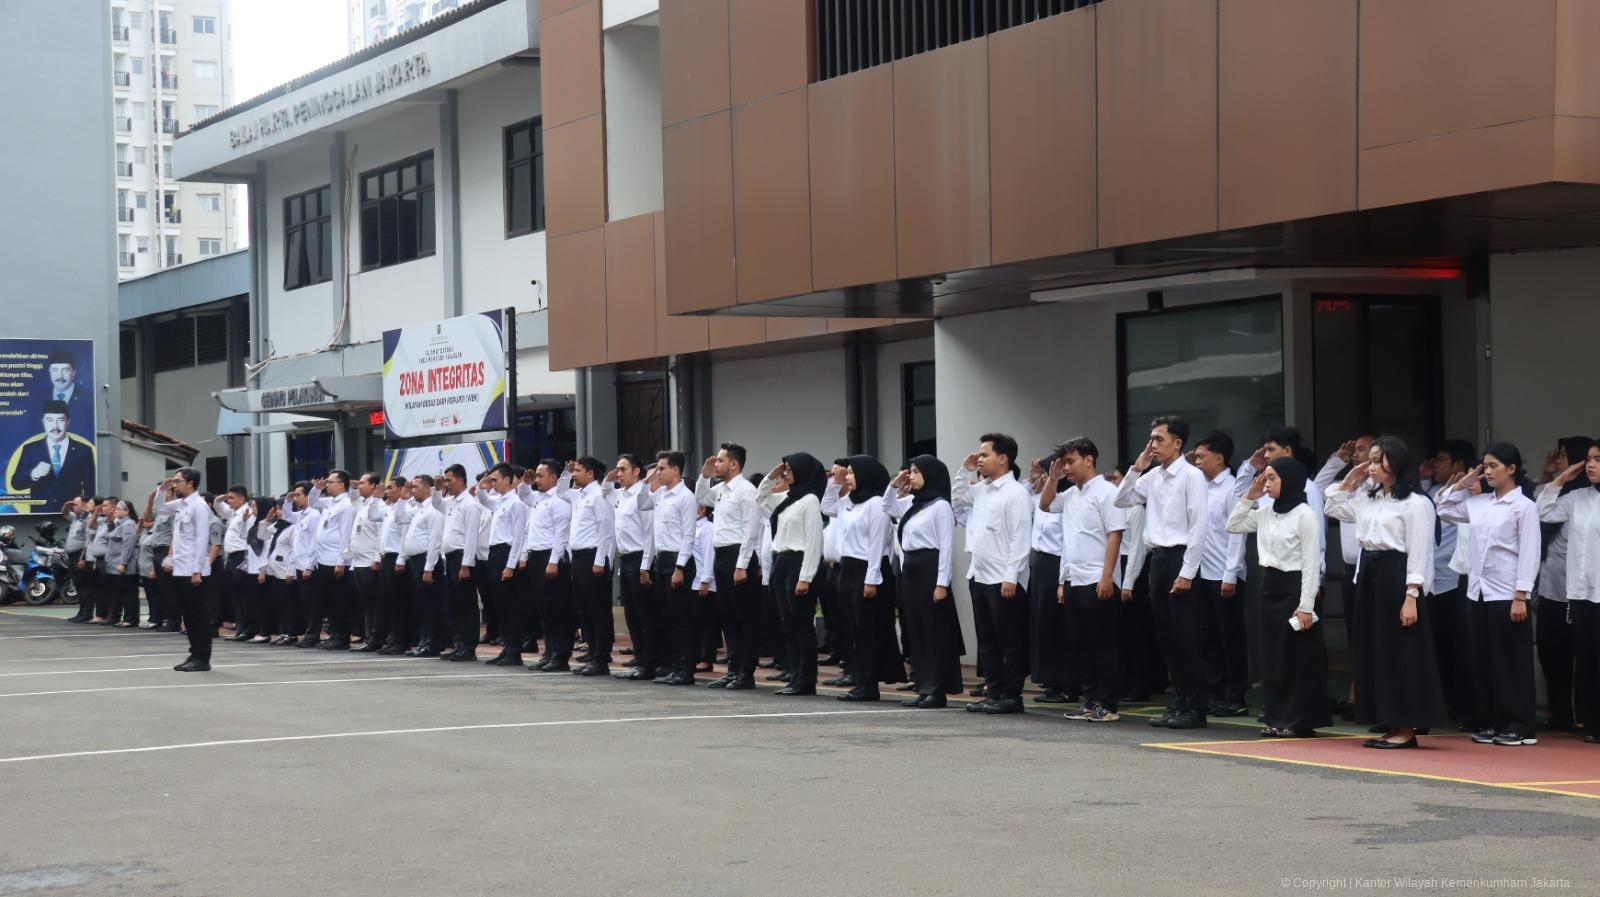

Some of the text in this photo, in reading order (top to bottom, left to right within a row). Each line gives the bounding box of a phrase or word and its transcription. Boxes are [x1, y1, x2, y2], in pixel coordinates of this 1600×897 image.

[375, 52, 431, 94] JAKARTA
[399, 361, 485, 397] ZONA INTEGRITAS
